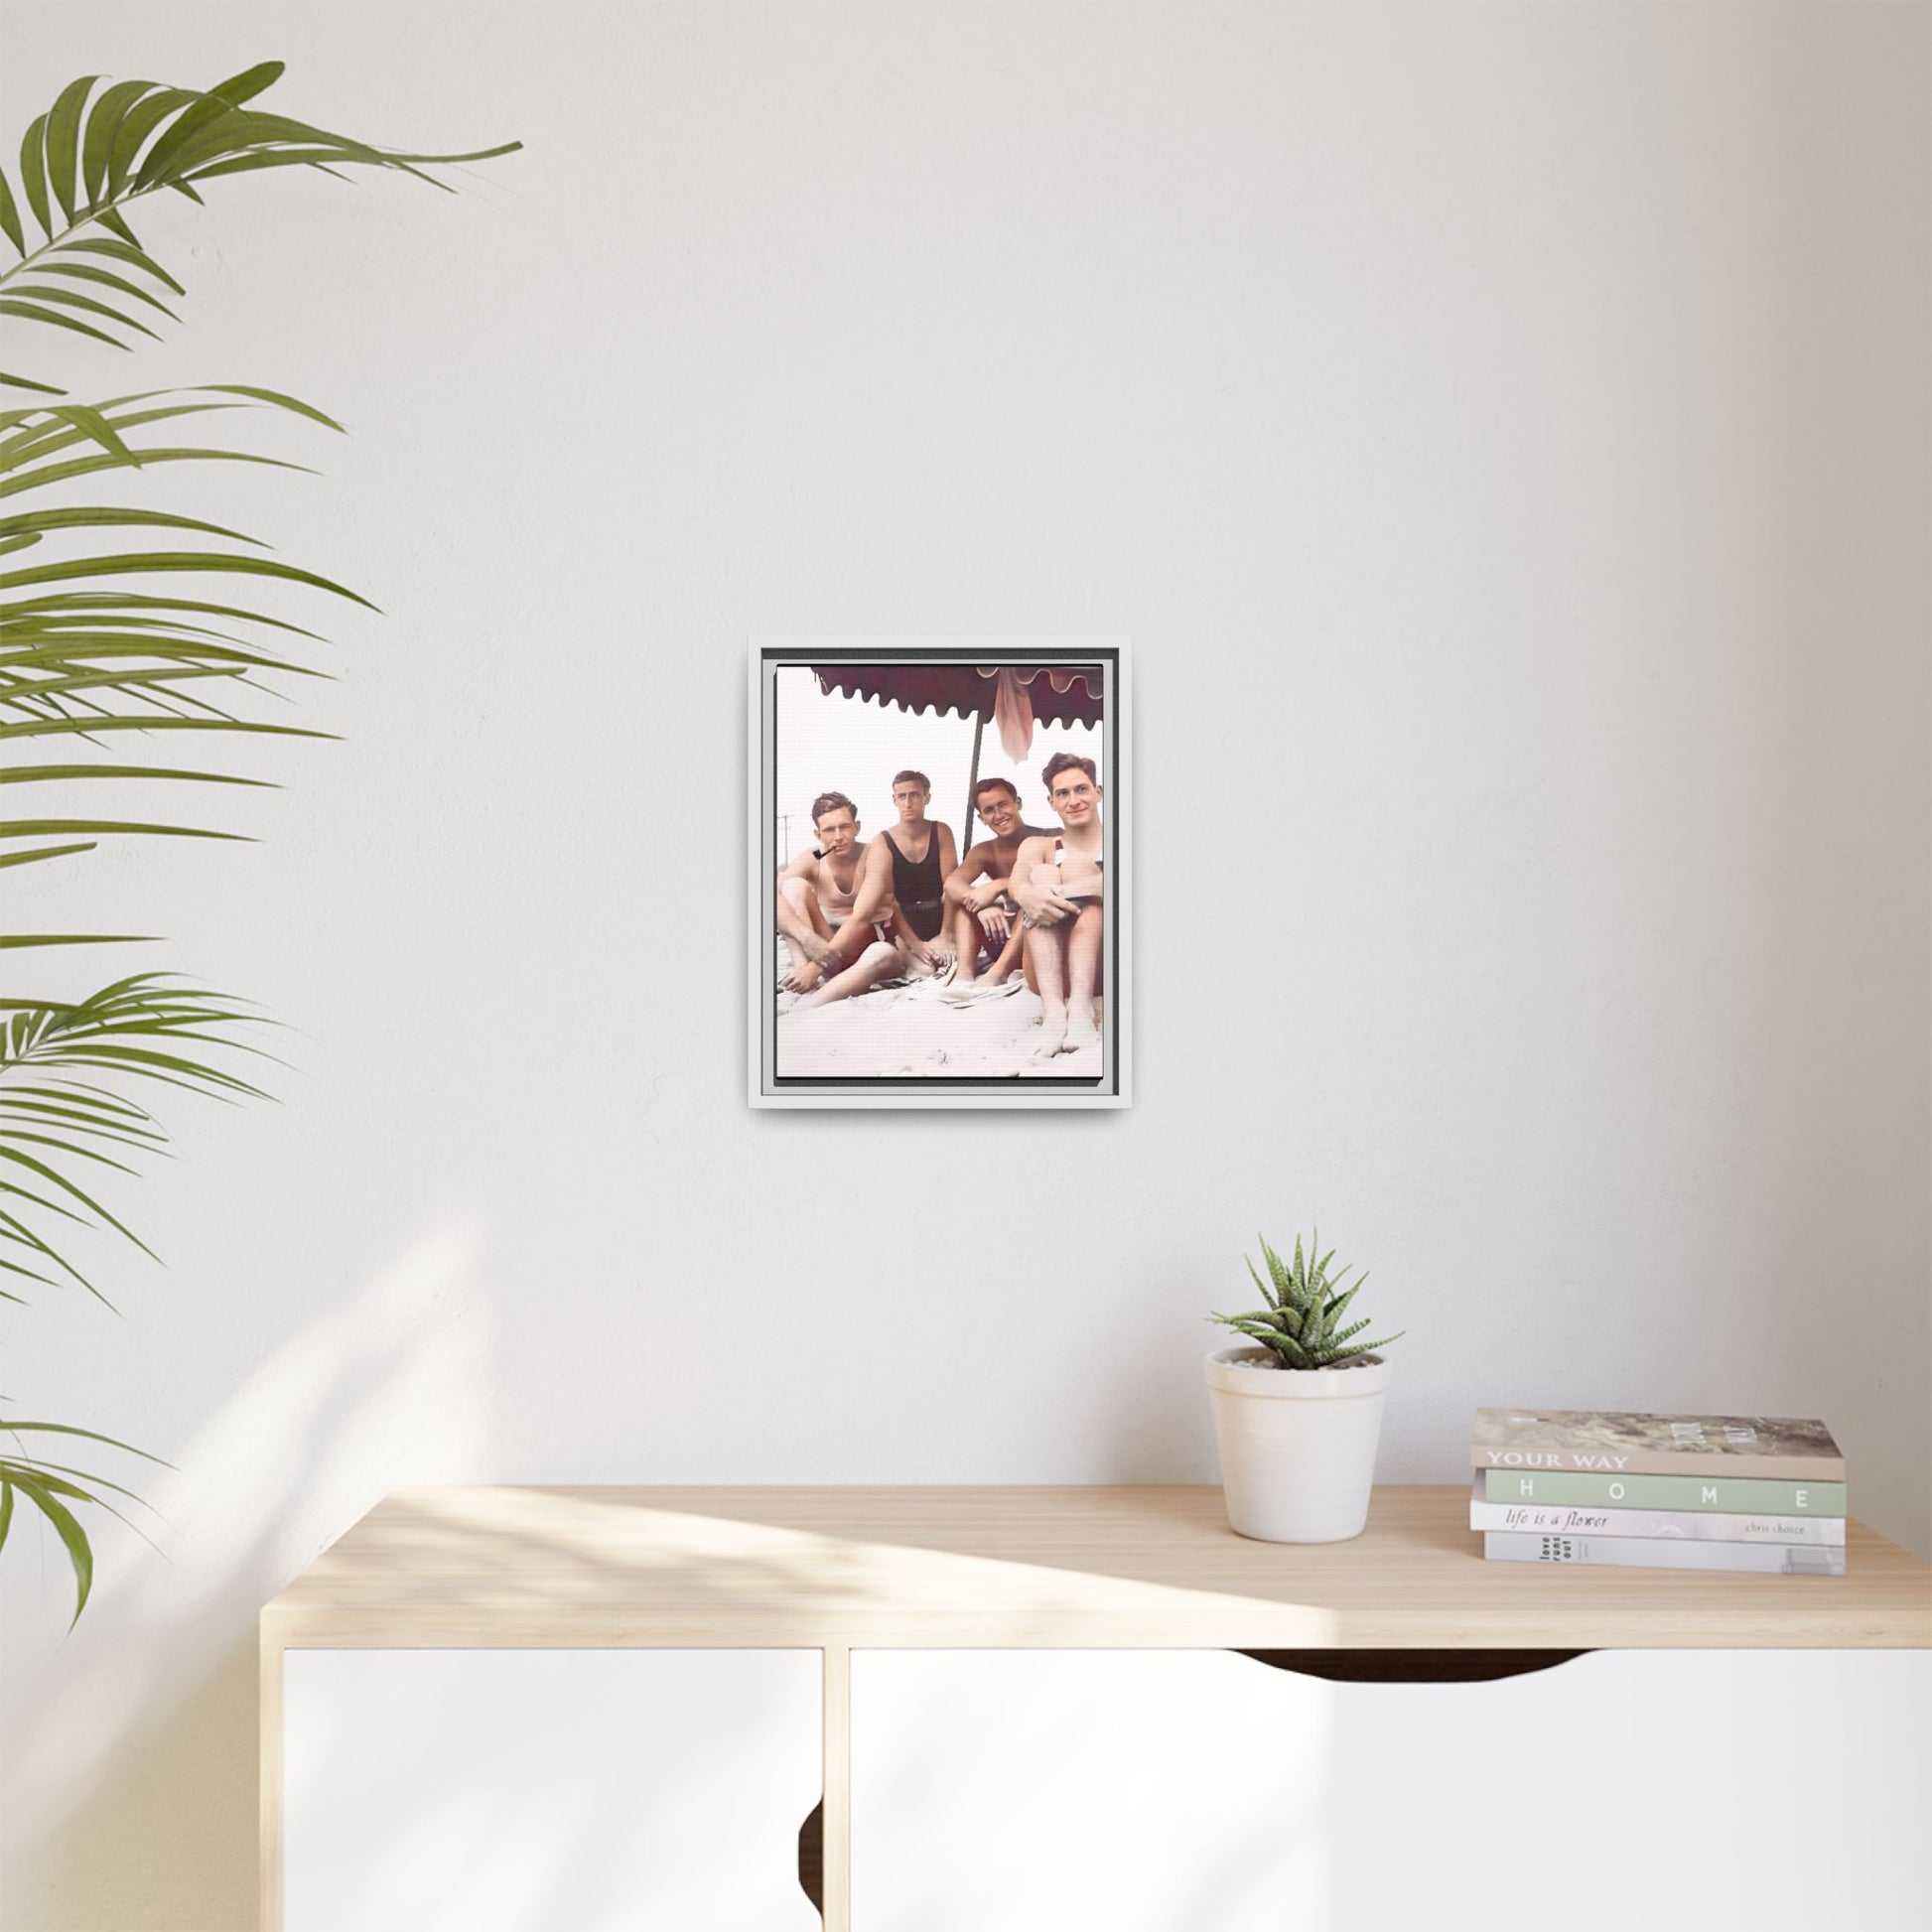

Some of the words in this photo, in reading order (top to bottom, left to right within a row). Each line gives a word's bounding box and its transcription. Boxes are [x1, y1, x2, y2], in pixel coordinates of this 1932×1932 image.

[1487, 1451, 1562, 1467] YOUR
[1573, 1454, 1628, 1469] WAY
[1505, 1509, 1529, 1528] life
[1534, 1512, 1547, 1525] is
[1551, 1515, 1560, 1525] a
[1563, 1511, 1608, 1531] flower
[1745, 1521, 1769, 1533] chris
[1772, 1522, 1805, 1535] choice
[1540, 1537, 1551, 1560] love
[1563, 1540, 1572, 1559] out
